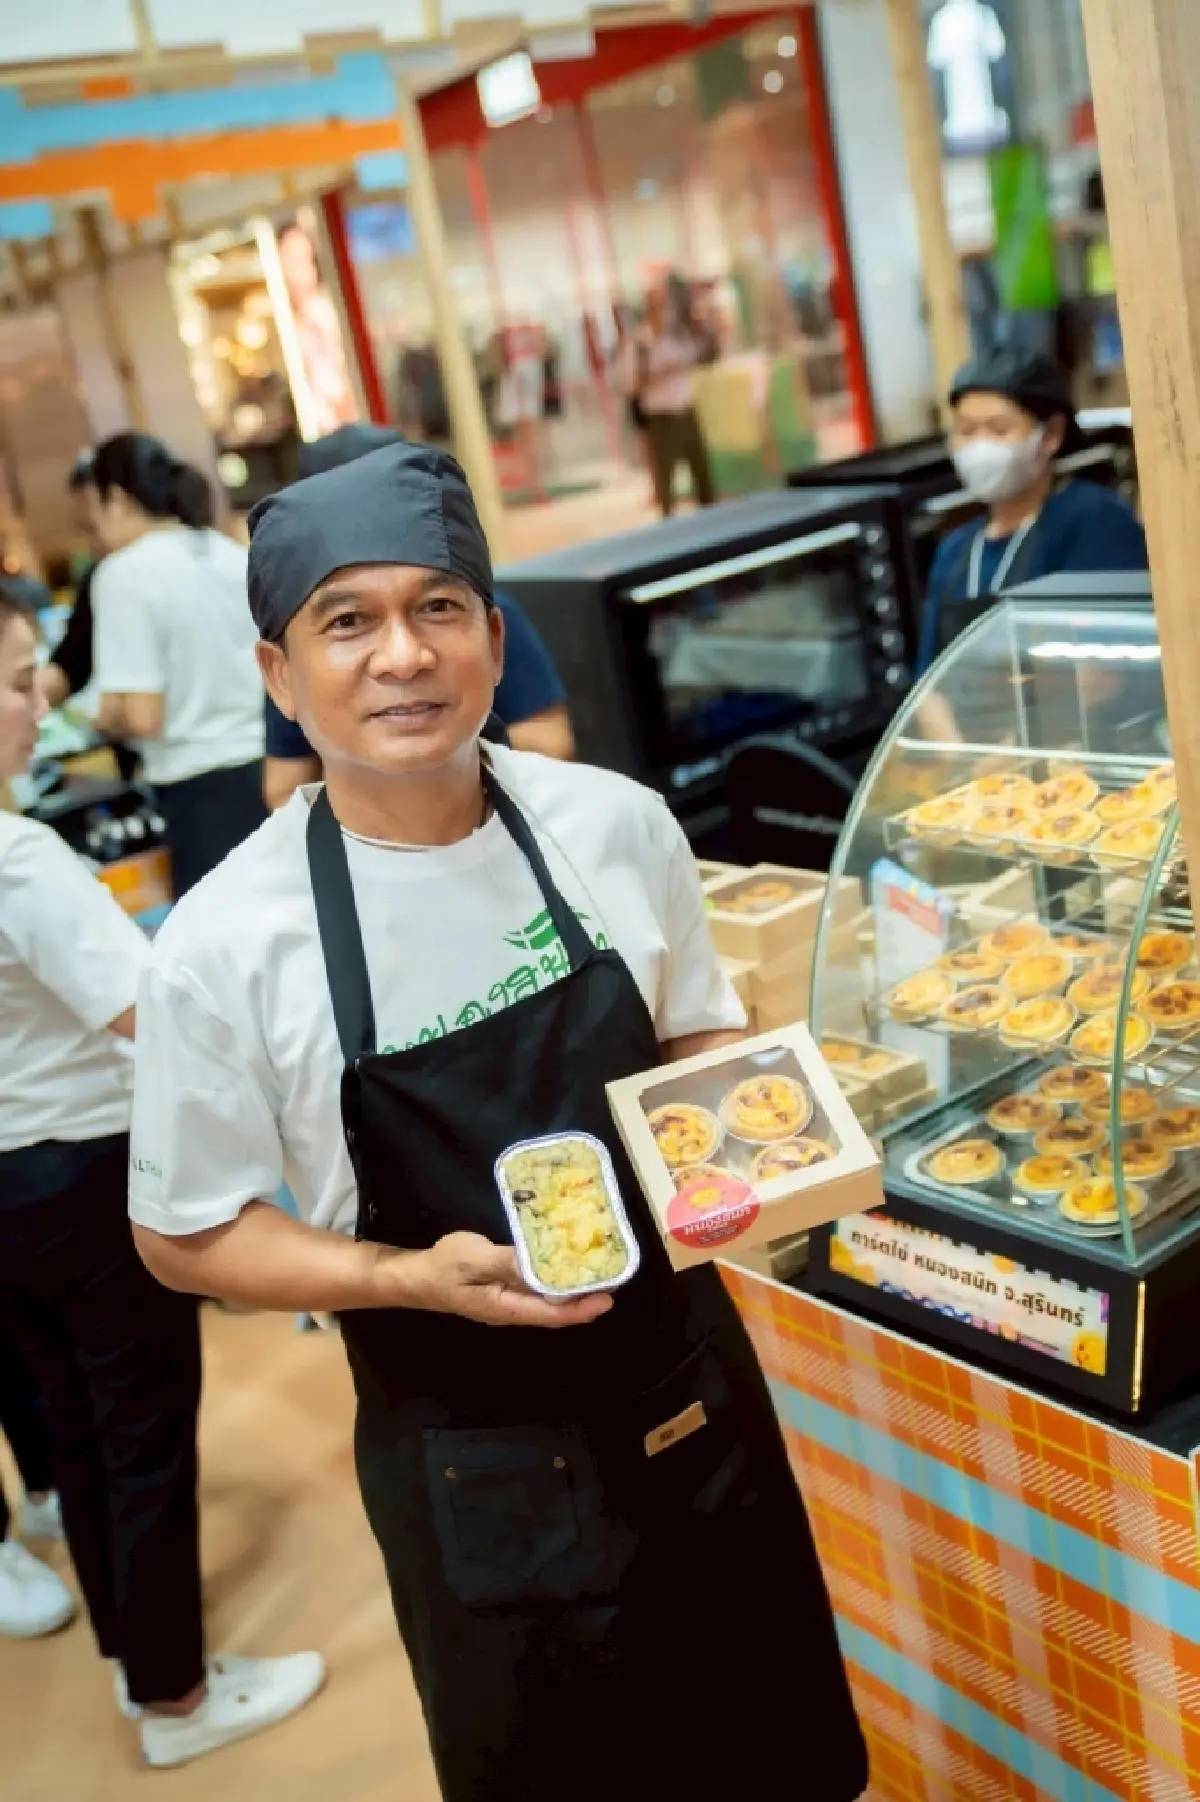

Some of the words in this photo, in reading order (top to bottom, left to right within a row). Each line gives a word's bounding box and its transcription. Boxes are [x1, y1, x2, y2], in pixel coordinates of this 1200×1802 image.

[913, 1251, 998, 1295] หนองสนิท
[1003, 1285, 1086, 1327] จ.สุรินทร์
